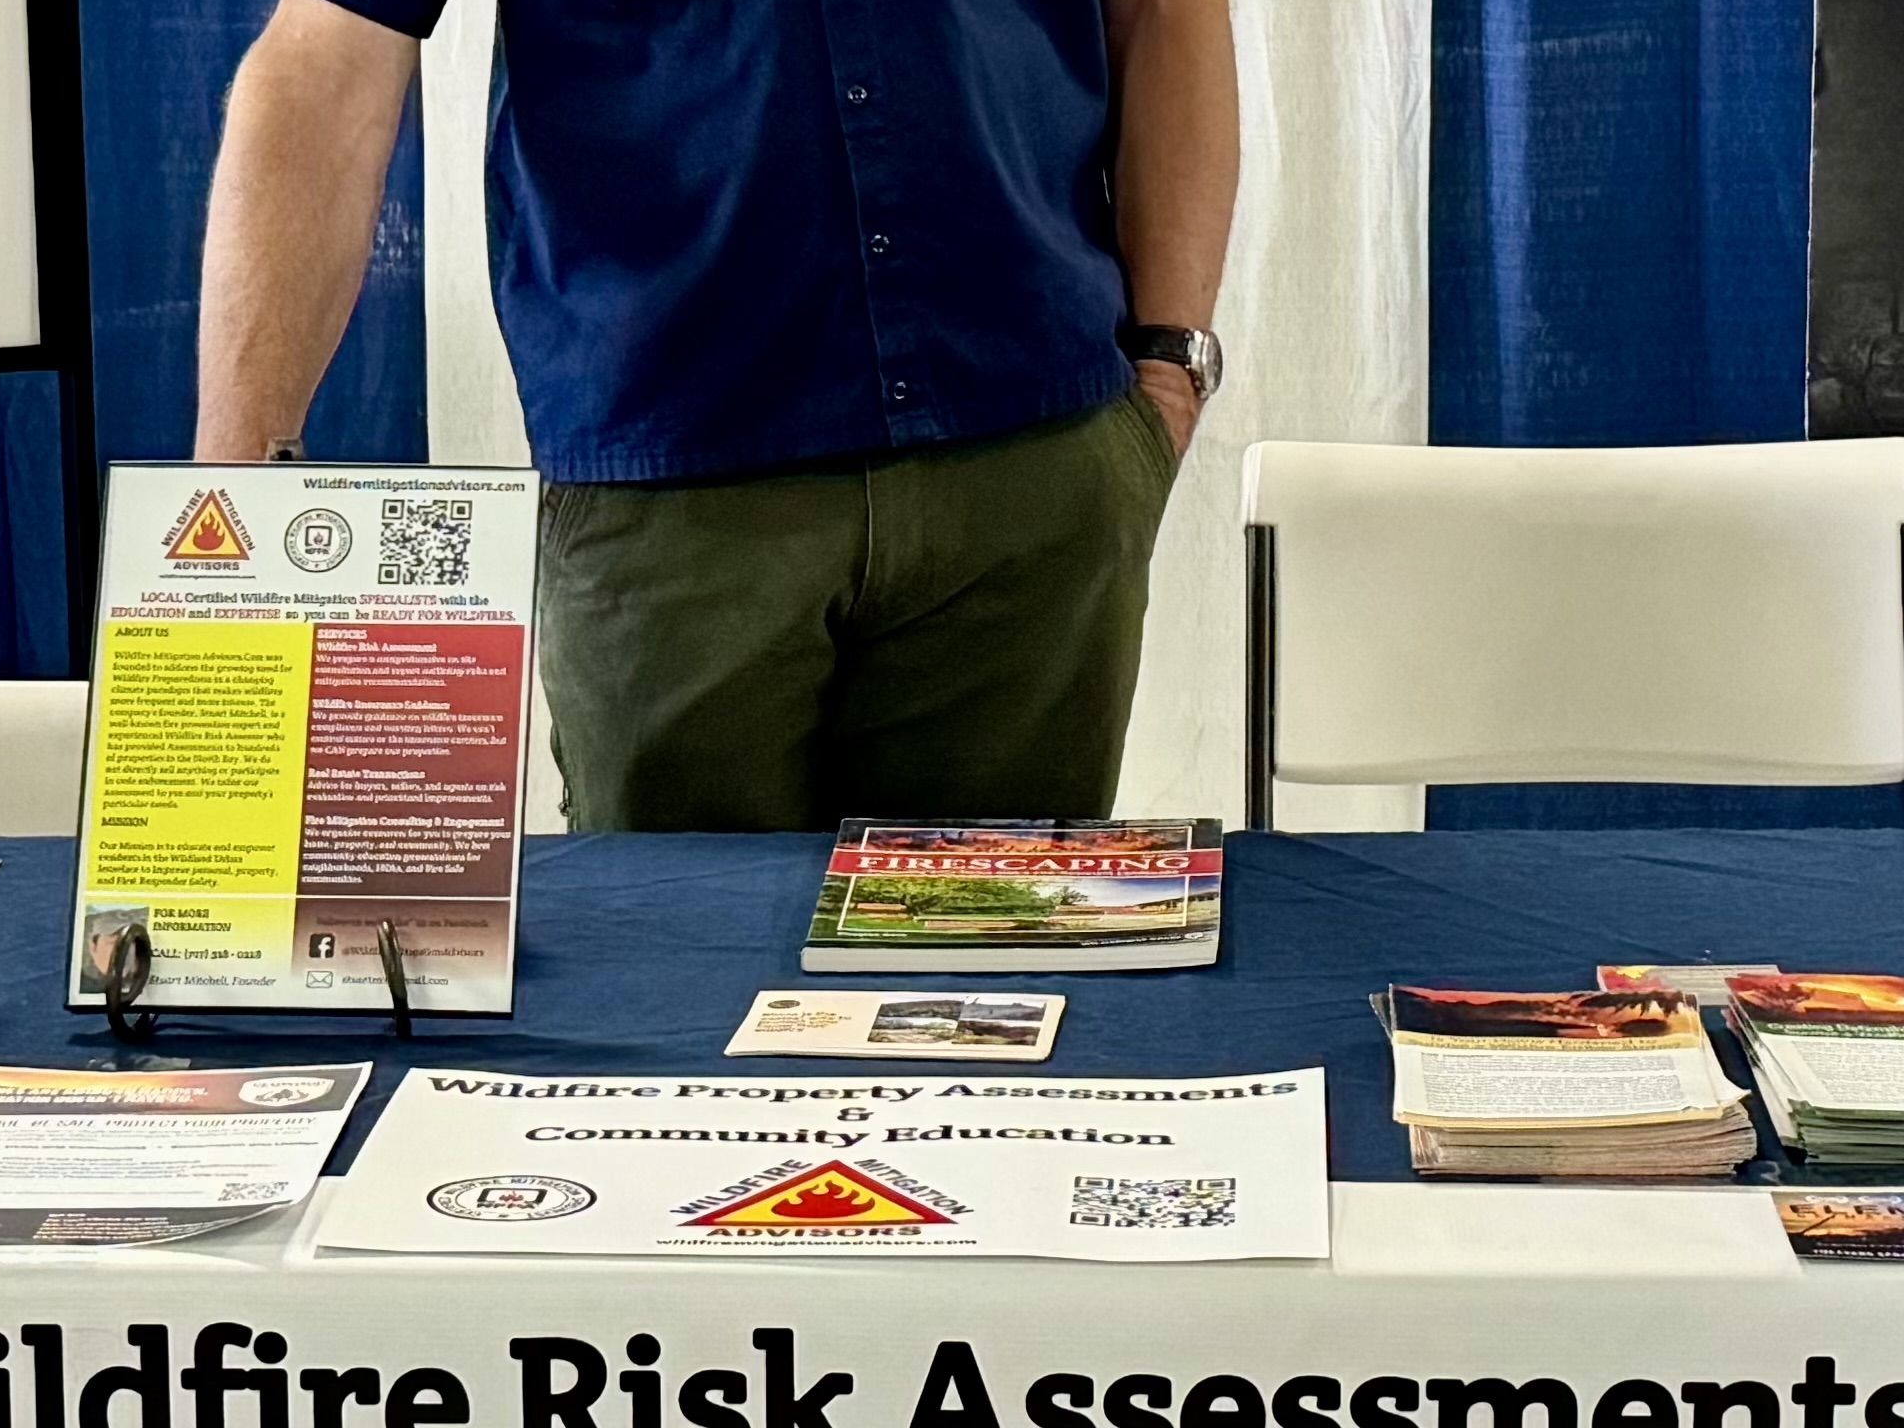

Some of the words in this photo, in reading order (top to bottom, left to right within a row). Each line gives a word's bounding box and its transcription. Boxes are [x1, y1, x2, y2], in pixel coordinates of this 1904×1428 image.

[218, 488, 255, 551] MITIGATION
[857, 856, 1192, 872] FIRESCAPING
[427, 1068, 667, 1099] Wildfire
[674, 1084, 924, 1103] Property
[927, 1070, 1298, 1101] Assessments
[836, 1106, 875, 1122] &
[524, 1126, 870, 1149] Community
[881, 1124, 1175, 1146] Education
[670, 1160, 813, 1216] WILDFIRE
[852, 1158, 975, 1216] MITIGATION
[706, 1226, 922, 1238] ADVISORS
